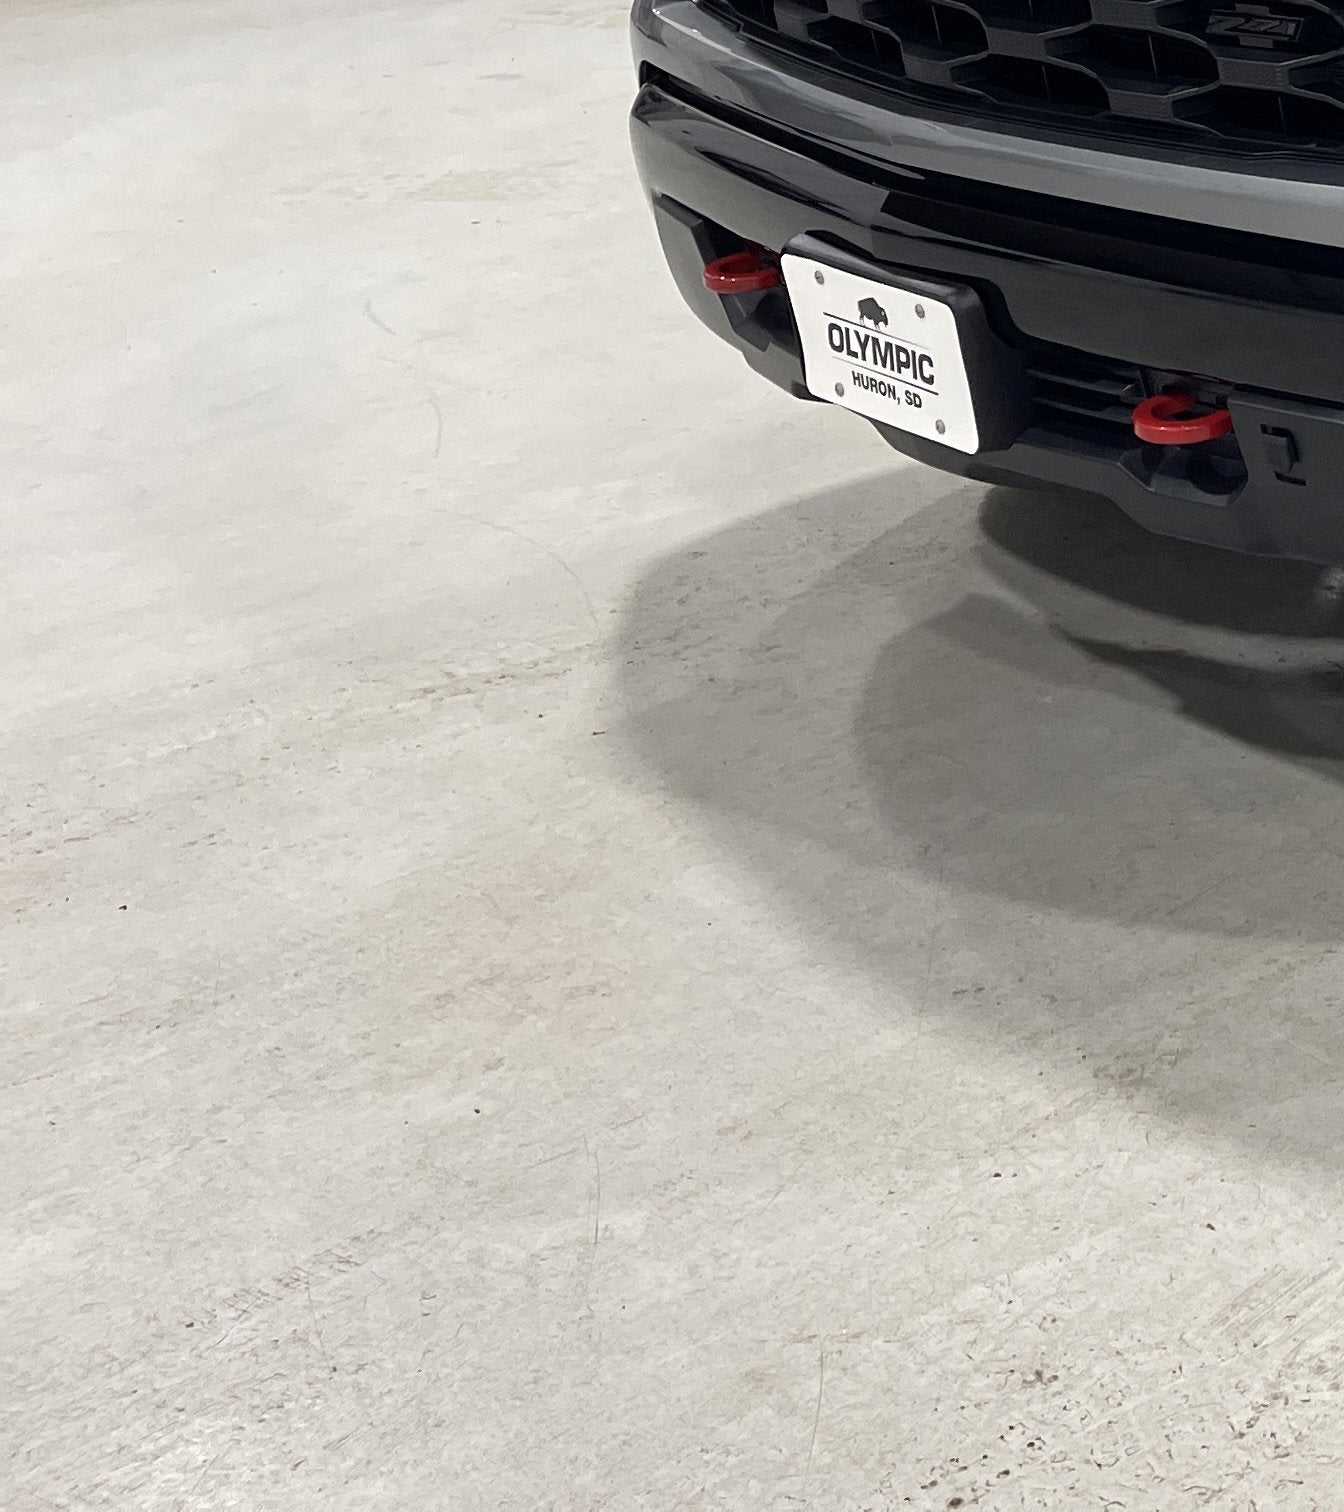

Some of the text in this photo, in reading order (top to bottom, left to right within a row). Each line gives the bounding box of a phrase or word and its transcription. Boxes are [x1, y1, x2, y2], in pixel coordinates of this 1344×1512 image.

[1205, 9, 1304, 43] Z71
[828, 322, 935, 385] OLYMPIC
[852, 370, 922, 409] HURON, SD
